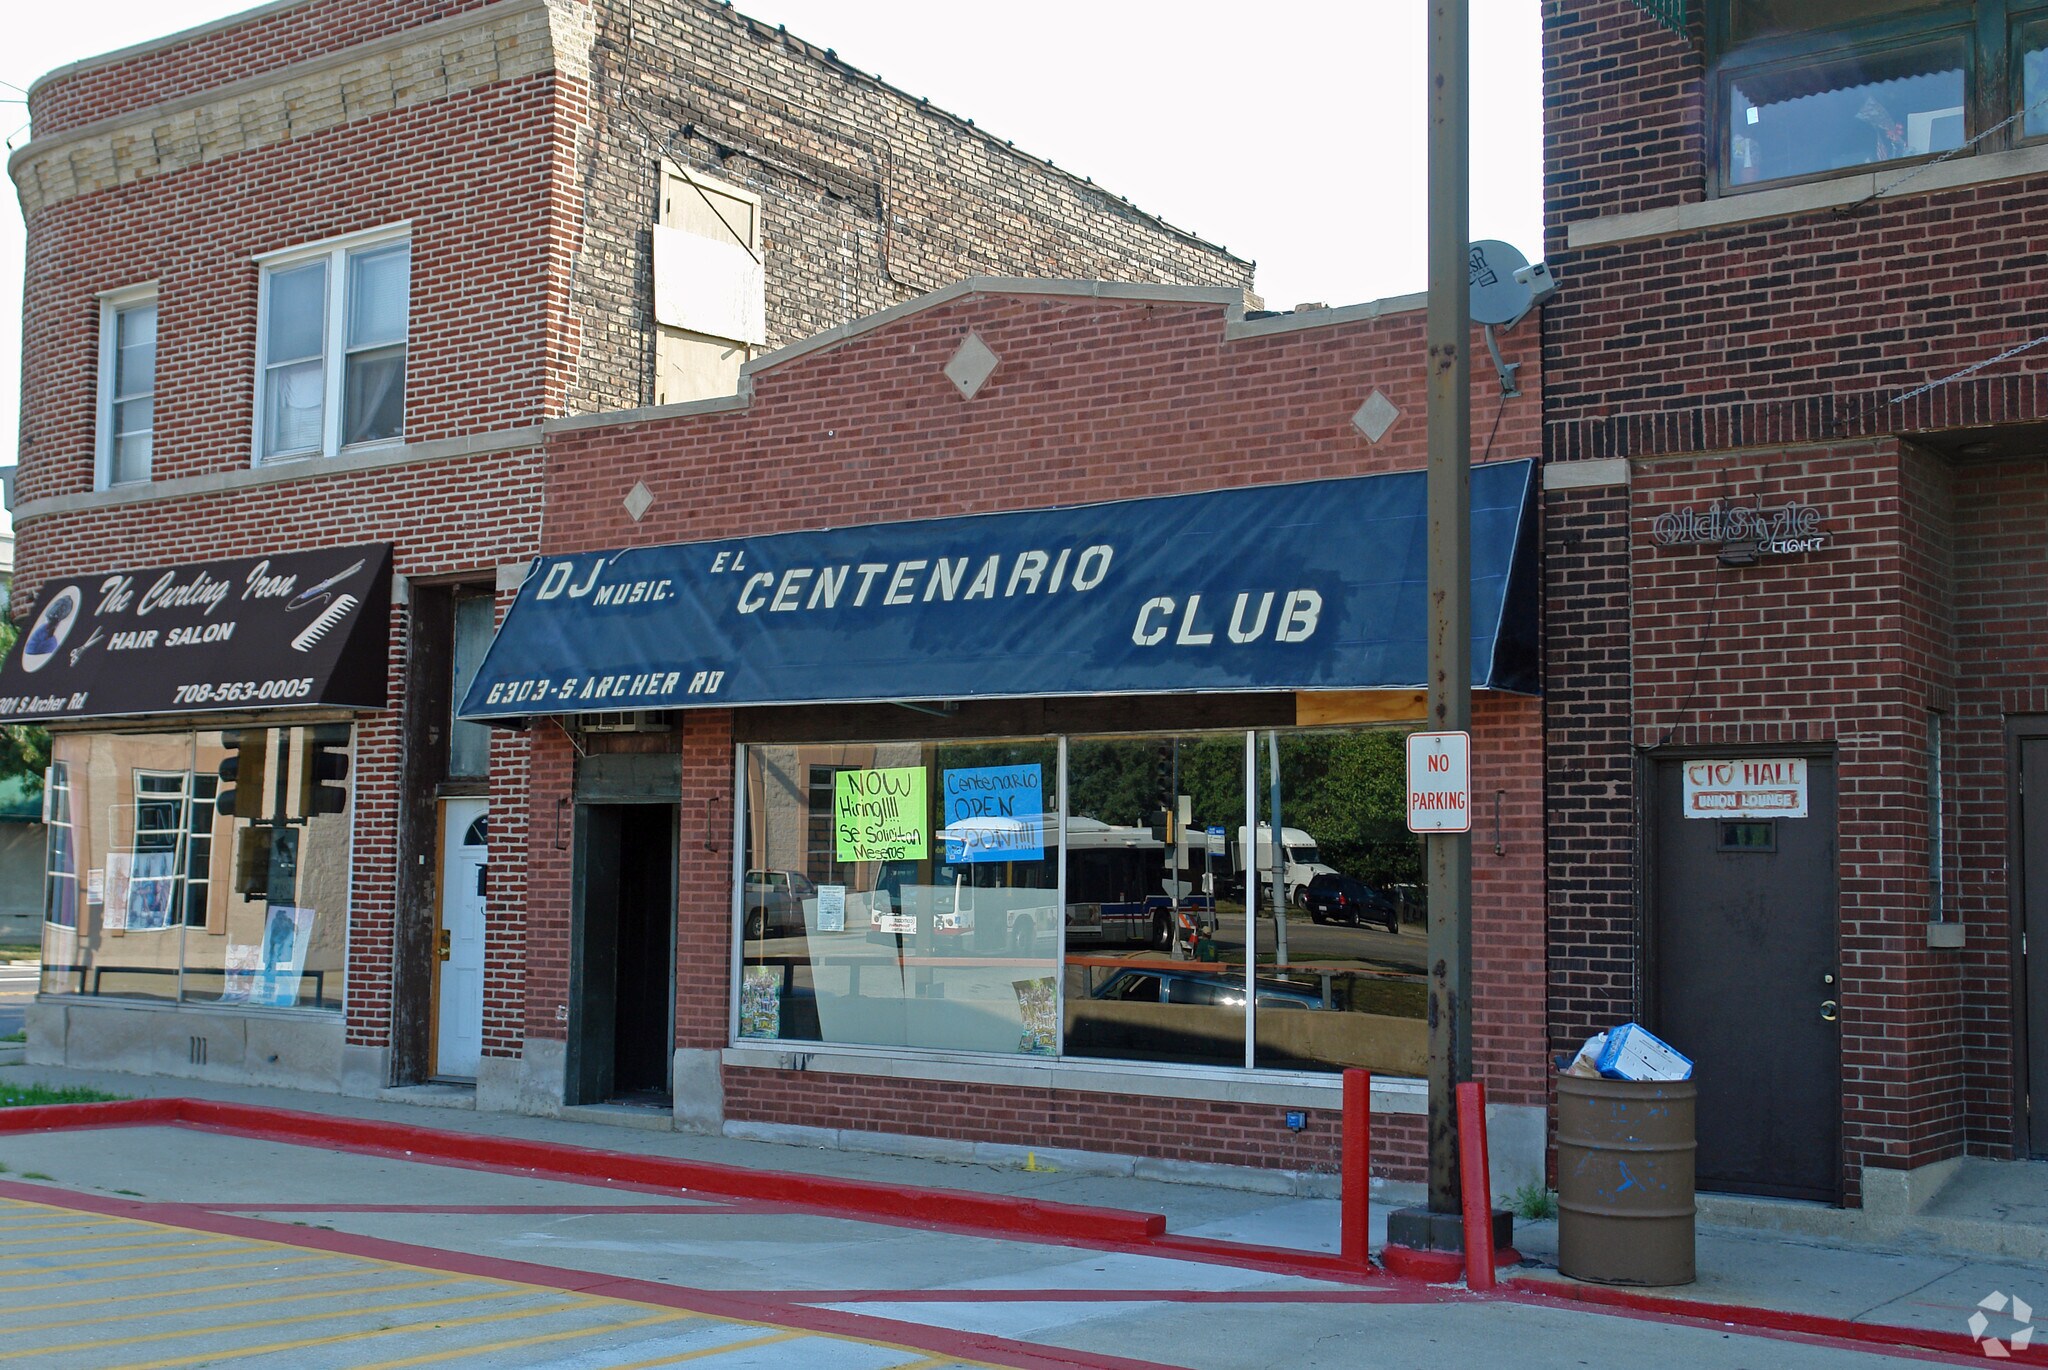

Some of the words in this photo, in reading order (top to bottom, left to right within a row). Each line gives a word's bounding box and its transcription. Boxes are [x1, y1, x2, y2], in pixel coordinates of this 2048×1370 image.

[1771, 537, 1825, 554] LIGHT
[710, 550, 746, 574] EL
[94, 574, 135, 617] The
[137, 569, 232, 617] Curling
[241, 559, 298, 601] Iron
[536, 558, 605, 600] DJ
[737, 544, 1114, 615] CENTENARIO
[1131, 589, 1323, 646] CLUB
[106, 629, 160, 651] HAIR
[164, 621, 237, 648] SALON
[172, 677, 315, 704] 708-563-0005
[687, 670, 726, 694] RD
[25, 694, 67, 713] Archer
[1427, 753, 1450, 773] NO
[1688, 763, 1735, 787] CIO
[1743, 762, 1801, 786] HALL
[847, 771, 911, 798] NOW
[954, 794, 1015, 820] OPEN
[1412, 790, 1466, 811] PARKING
[1698, 794, 1737, 808] UNION
[1741, 793, 1793, 807] LOUNGE
[840, 823, 861, 843] Se
